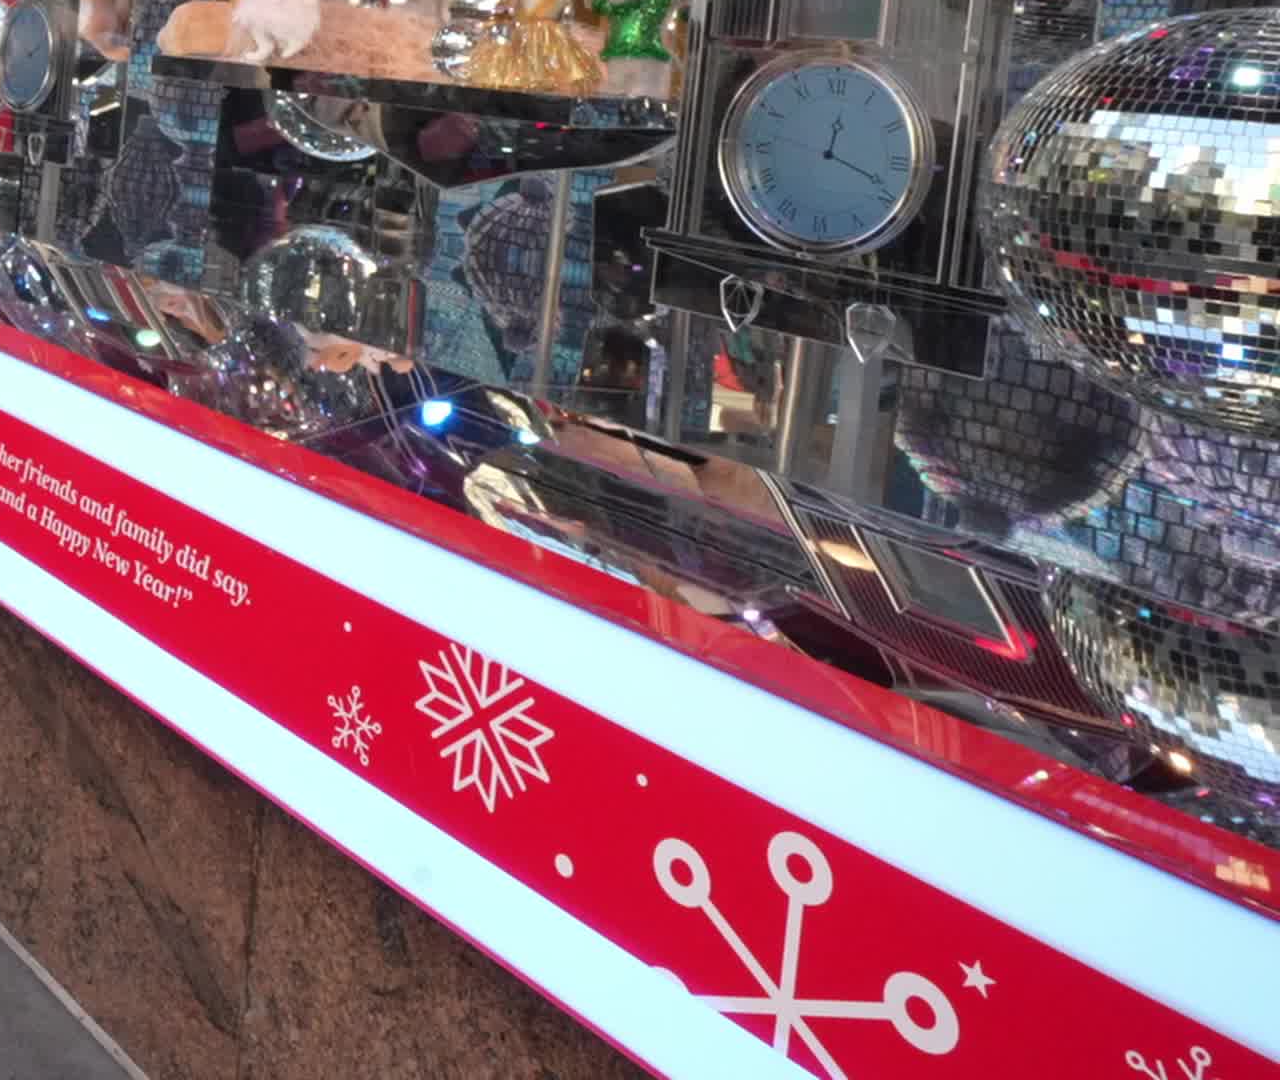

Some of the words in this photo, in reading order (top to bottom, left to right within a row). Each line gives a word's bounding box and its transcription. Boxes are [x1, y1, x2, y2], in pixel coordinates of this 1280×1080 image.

[19, 458, 77, 505] friends
[79, 494, 114, 527] and
[111, 510, 173, 565] family
[175, 544, 211, 581] did
[213, 569, 251, 607] say.
[27, 503, 38, 522] a
[39, 505, 92, 558] Happy
[92, 537, 130, 577] New
[133, 559, 193, 609] Year!”
